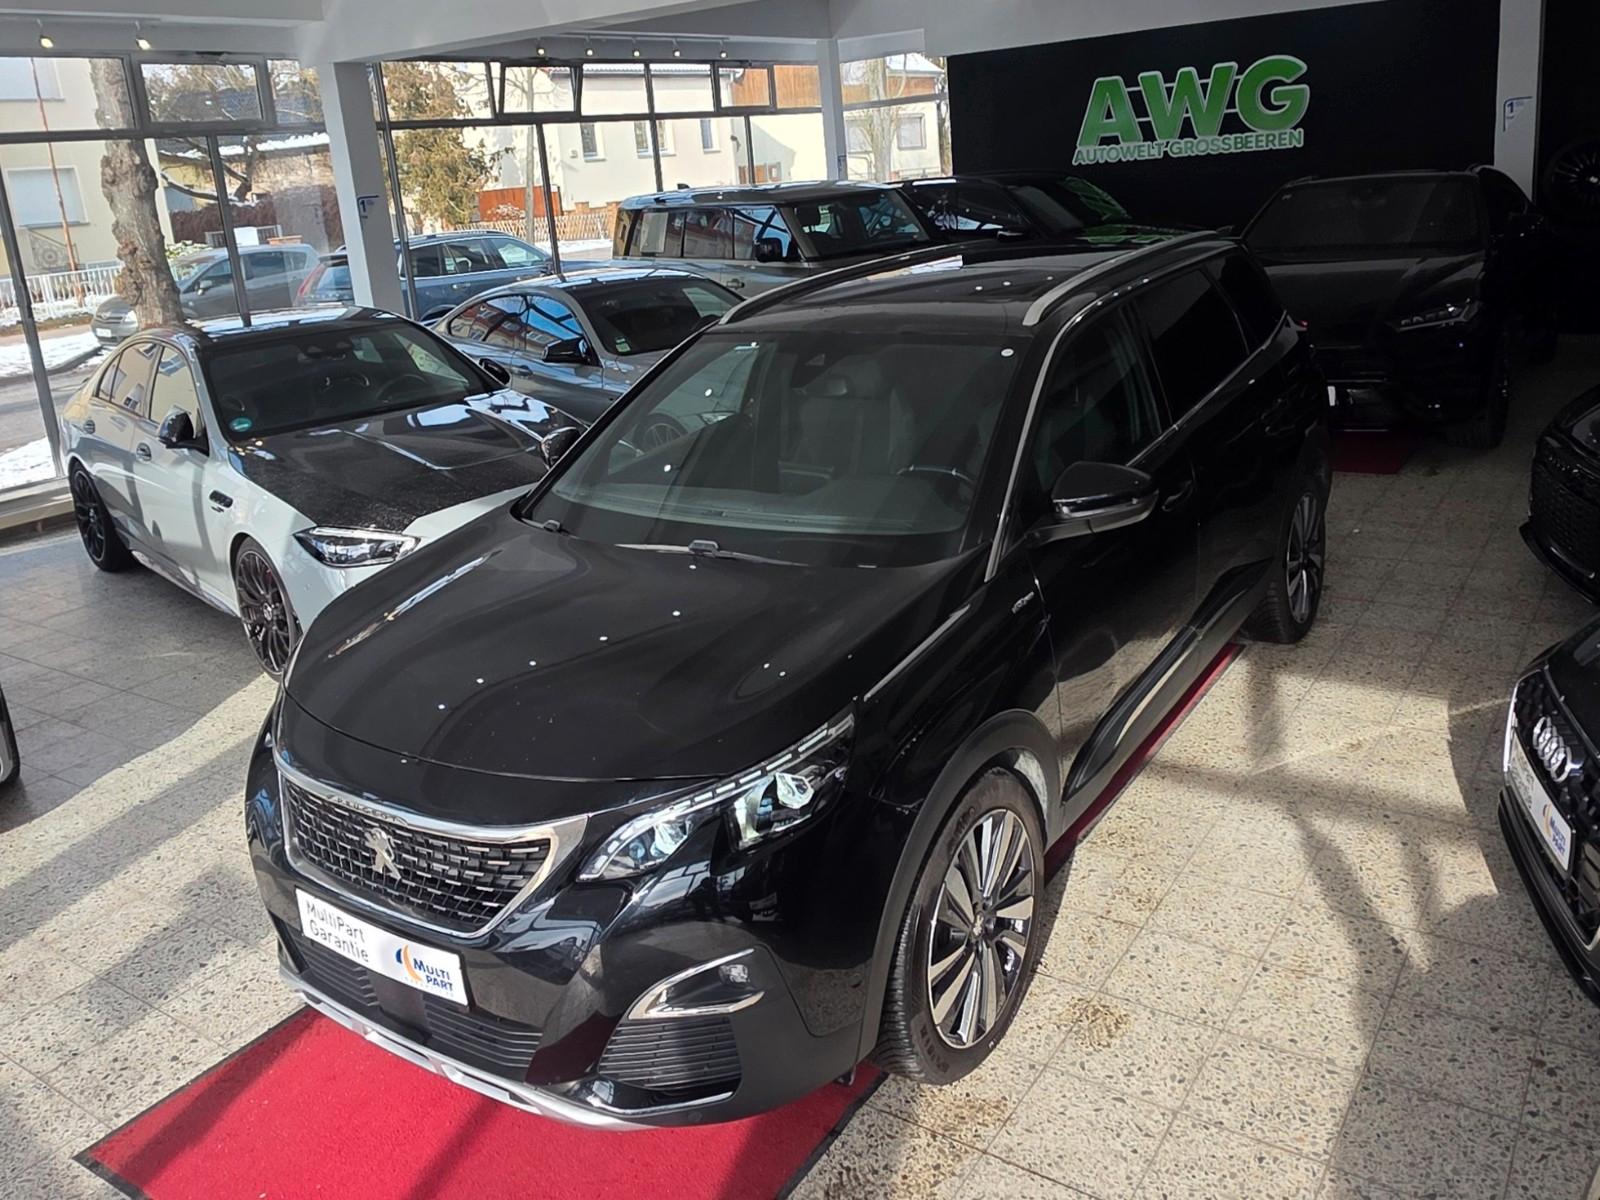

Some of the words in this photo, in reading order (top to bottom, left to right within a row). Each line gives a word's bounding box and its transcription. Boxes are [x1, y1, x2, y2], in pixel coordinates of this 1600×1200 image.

[1076, 55, 1310, 146] AWG
[1073, 142, 1165, 165] AUTOWELT
[1168, 129, 1304, 157] GROSSBEEREN
[306, 901, 365, 942] MultiPart
[309, 918, 369, 963] Garantie
[426, 974, 453, 992] PART
